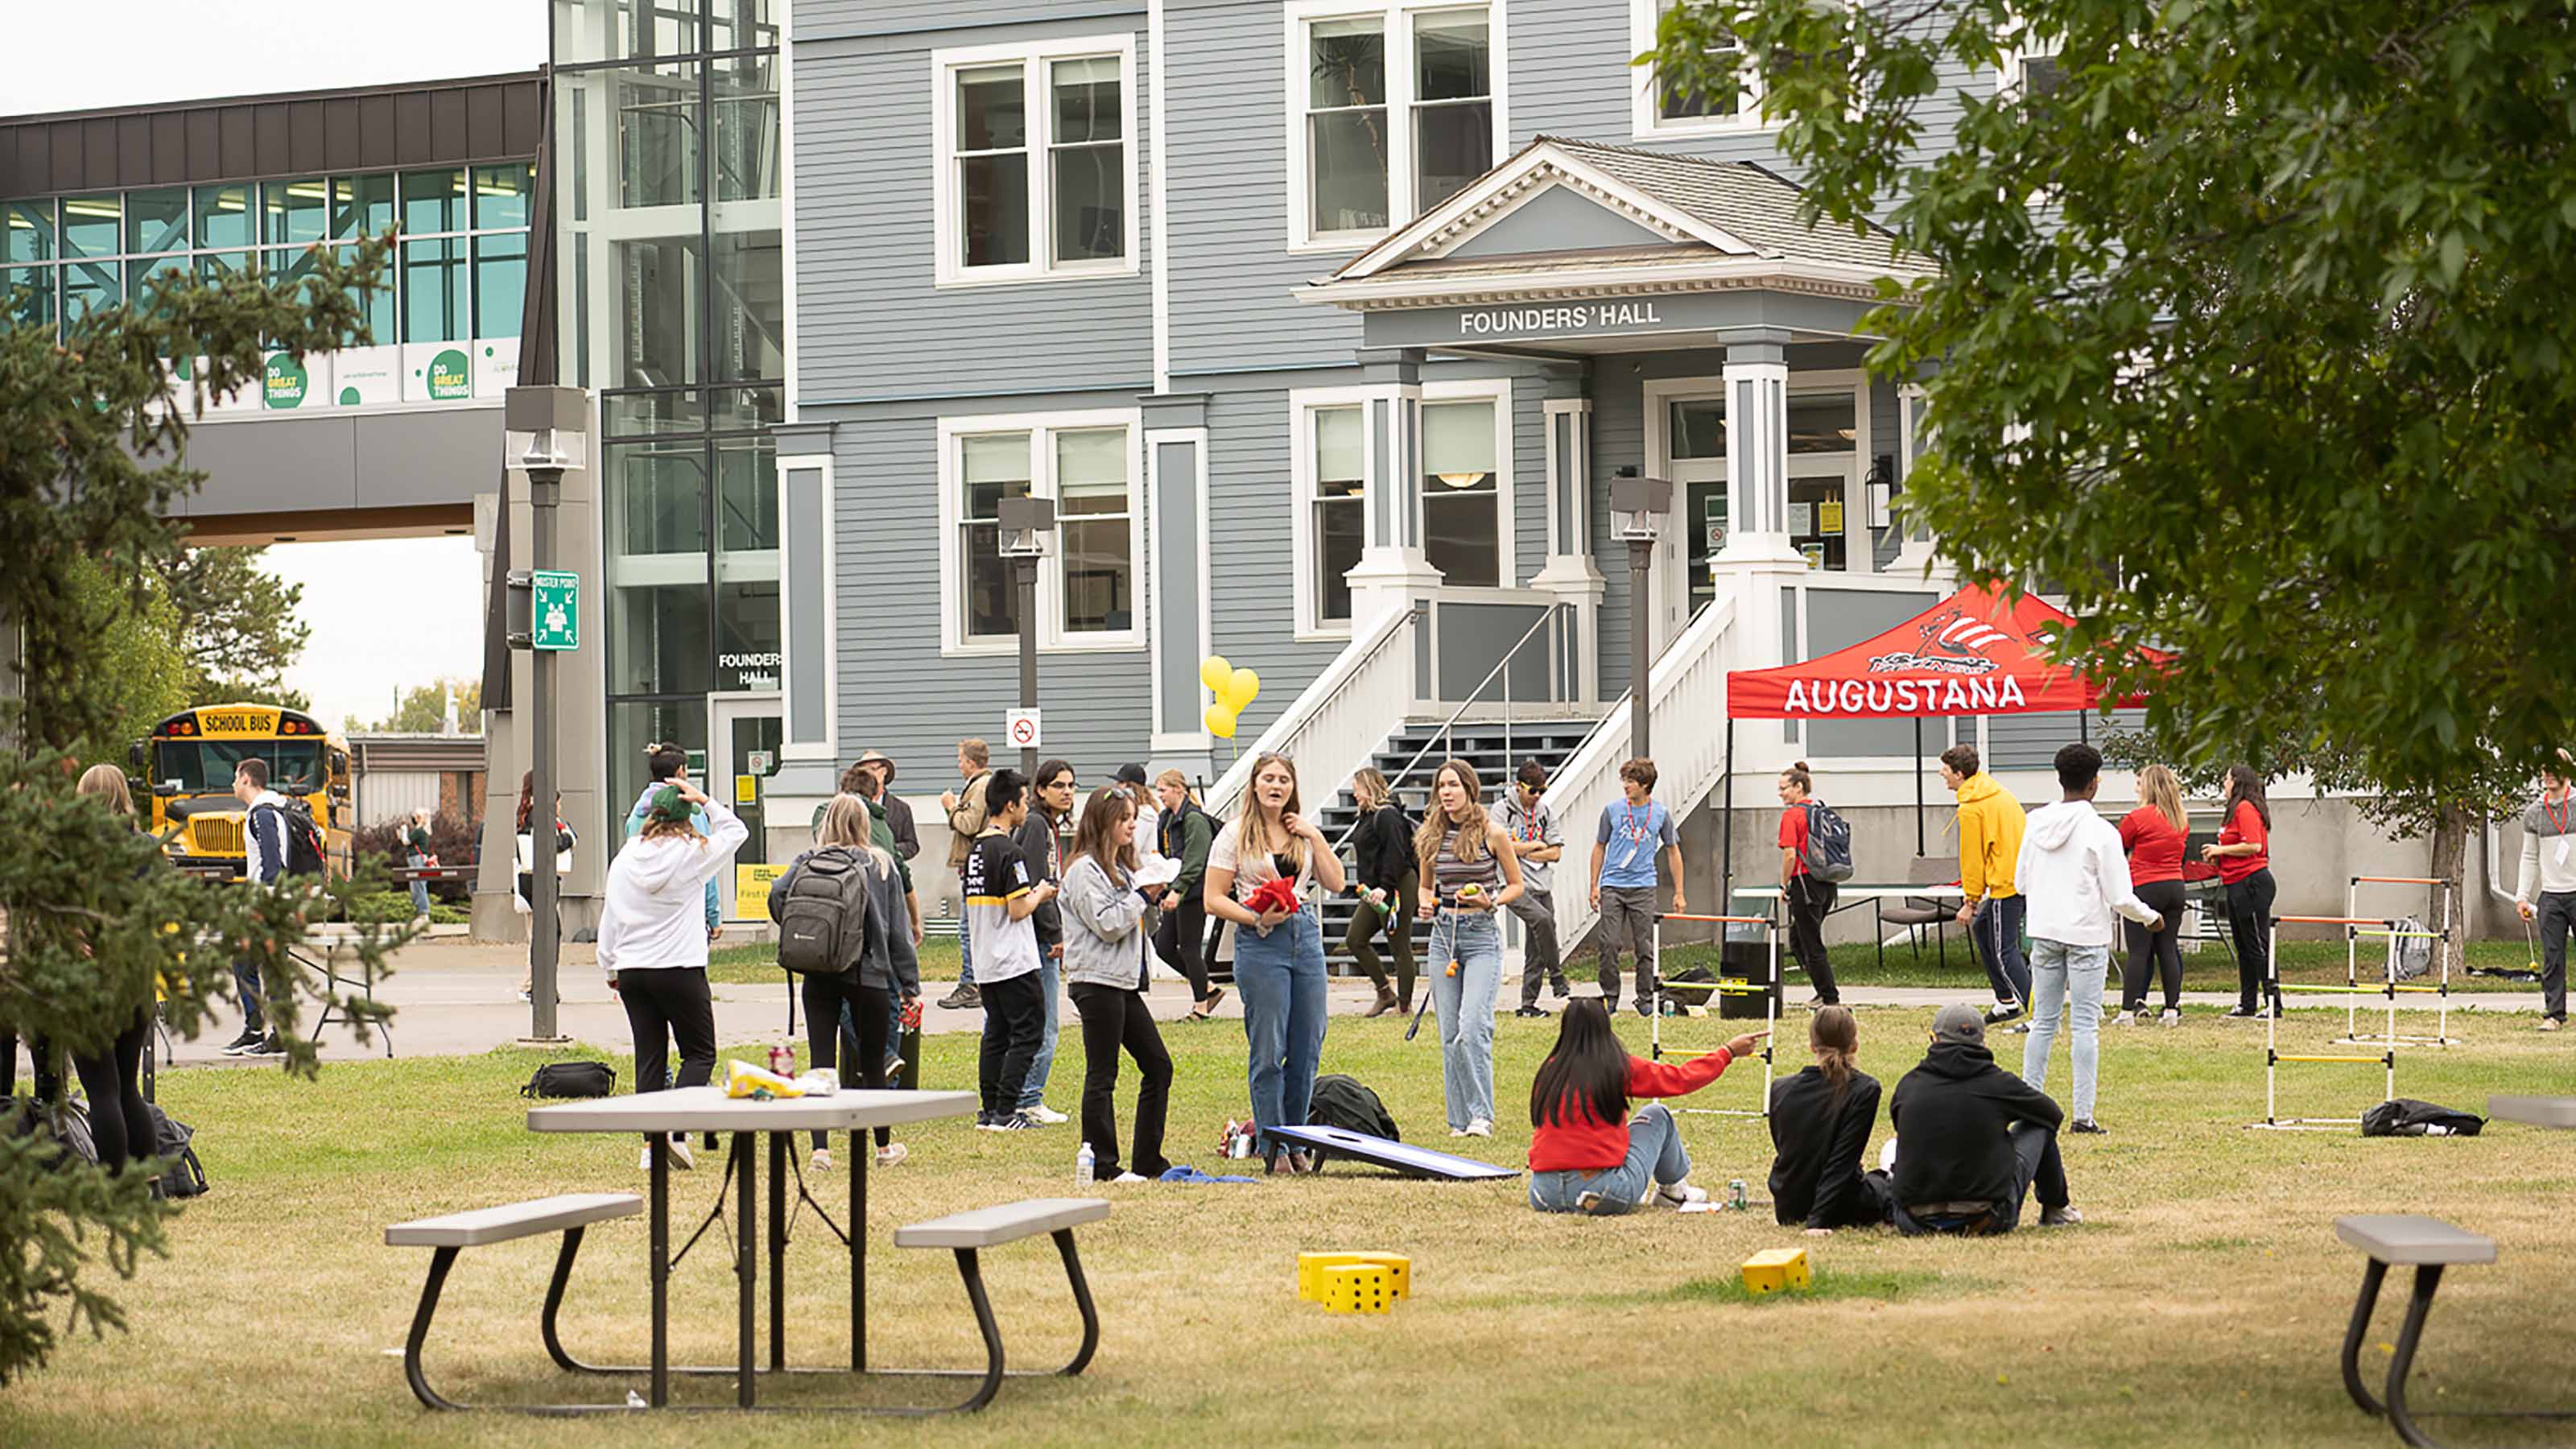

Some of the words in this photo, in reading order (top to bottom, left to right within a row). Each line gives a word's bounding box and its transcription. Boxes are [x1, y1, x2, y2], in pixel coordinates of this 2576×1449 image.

[1600, 303, 1660, 325] HALL
[268, 367, 280, 377] DO
[434, 364, 447, 374] DO
[268, 376, 296, 387] GREAT
[434, 374, 464, 386] GREAT
[268, 387, 301, 398] THINGS
[435, 385, 469, 397] THINGS
[719, 654, 781, 667] FOUNDER
[739, 671, 771, 684] HALL
[1784, 675, 2025, 712] AUGUSTANA
[206, 715, 246, 731] SCHOOL
[250, 715, 270, 731] BUS
